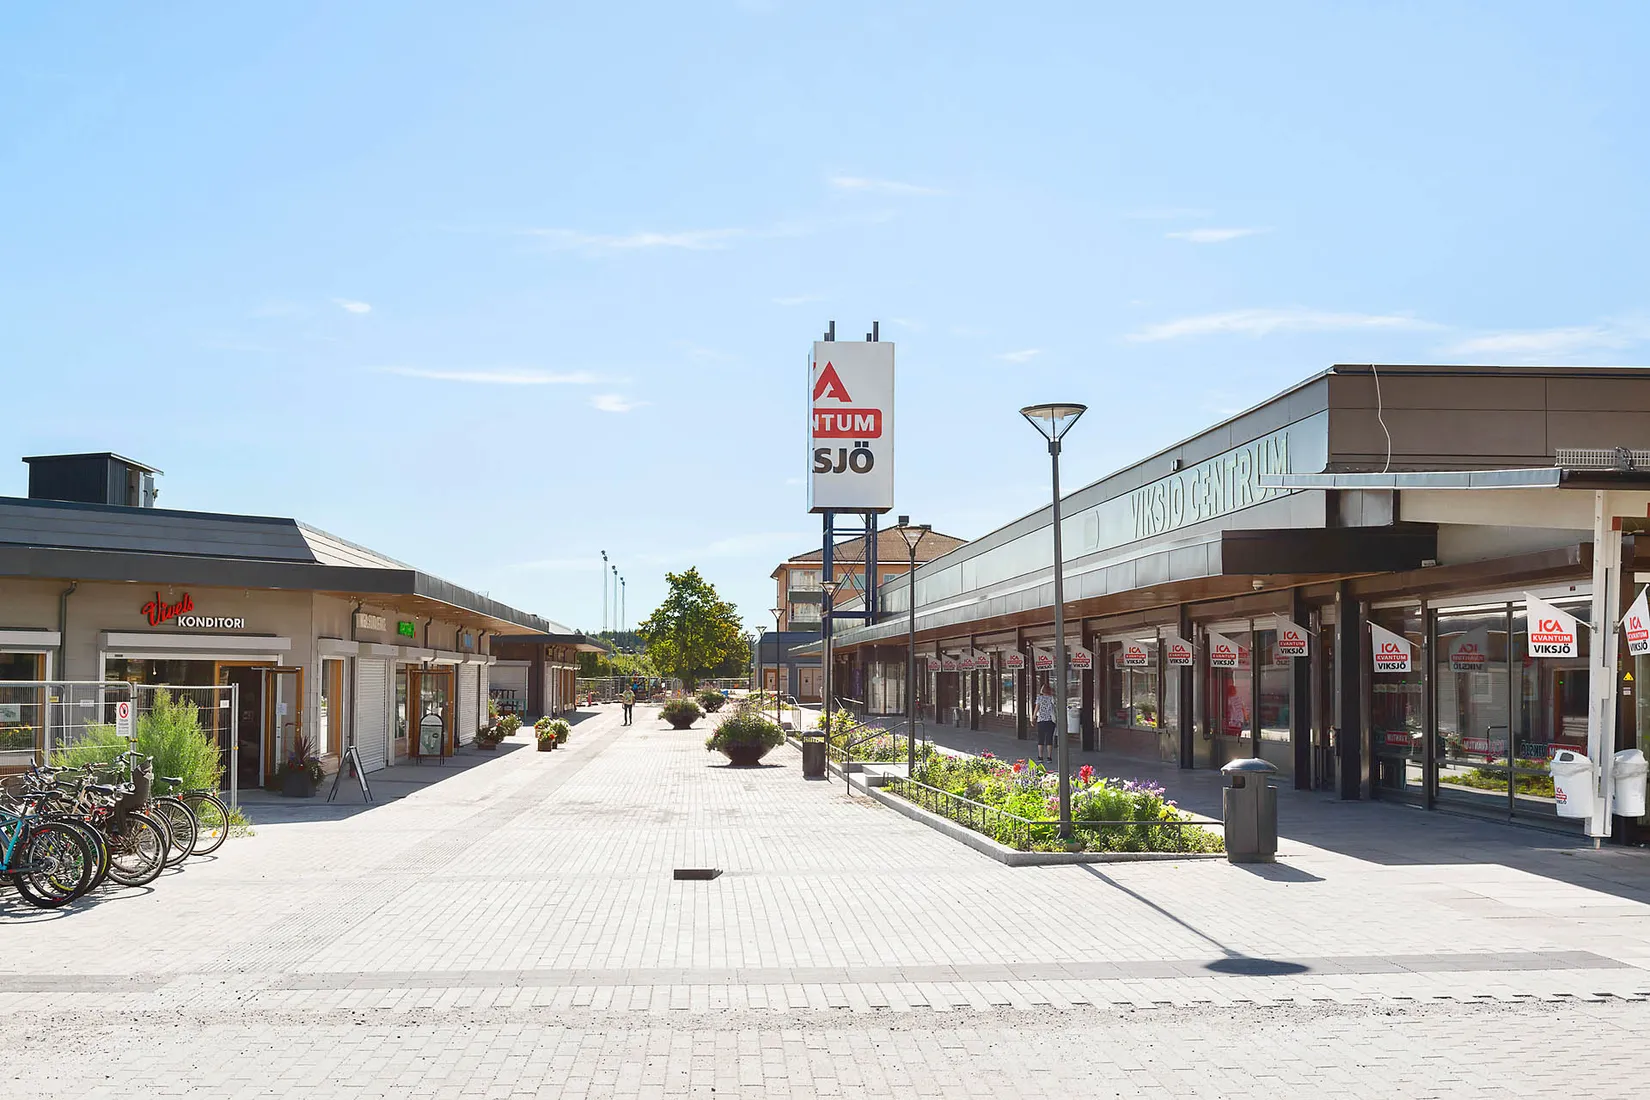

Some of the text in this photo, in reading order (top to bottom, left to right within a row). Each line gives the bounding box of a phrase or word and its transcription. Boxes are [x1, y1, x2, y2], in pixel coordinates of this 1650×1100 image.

[812, 441, 874, 473] SJÖ
[1191, 432, 1292, 521] CENTRUM
[141, 591, 194, 626] Vivels
[177, 616, 245, 628] KONDITORI
[1539, 619, 1564, 632] ICA
[1630, 616, 1643, 629] ICA
[1283, 631, 1299, 640] ICA
[1532, 634, 1571, 642] KVANTUM
[1381, 643, 1400, 653] ICA
[1533, 643, 1571, 654] VIKSJÖ
[1630, 640, 1648, 651] VIKSJÖ
[1378, 661, 1406, 670] VIKSJÖ
